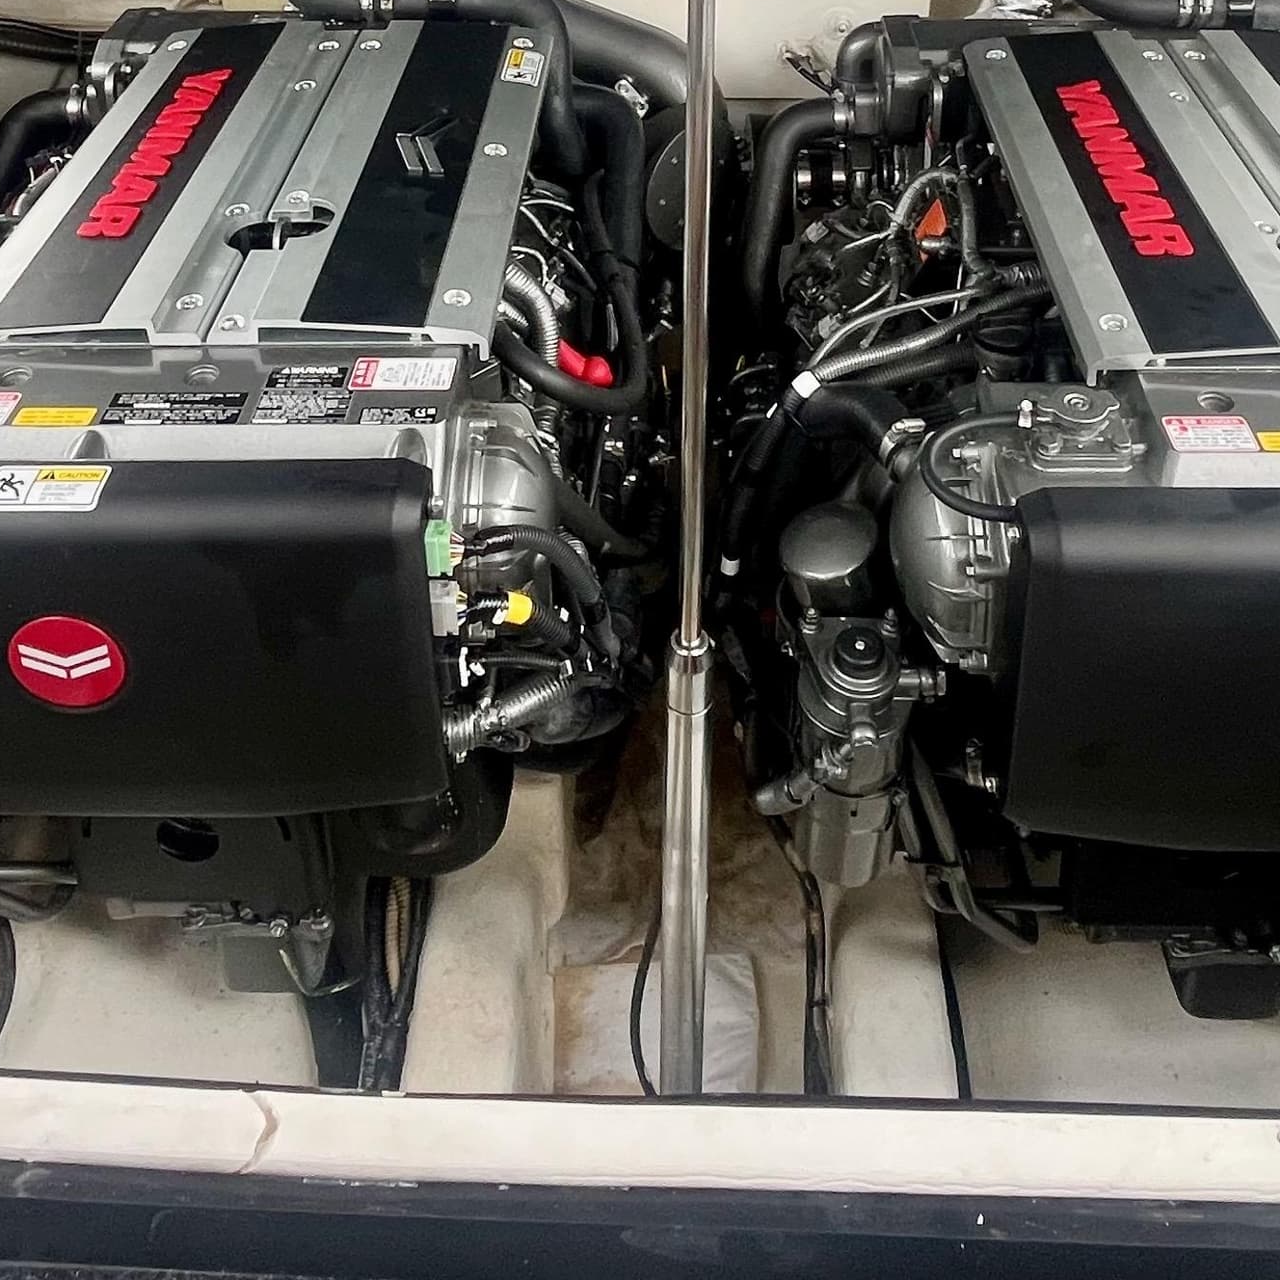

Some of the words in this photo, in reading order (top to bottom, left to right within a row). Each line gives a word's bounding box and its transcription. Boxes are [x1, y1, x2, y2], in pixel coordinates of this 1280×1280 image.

[77, 69, 231, 239] YANMAR
[1058, 80, 1192, 256] YANMAR
[290, 366, 339, 375] WARNING
